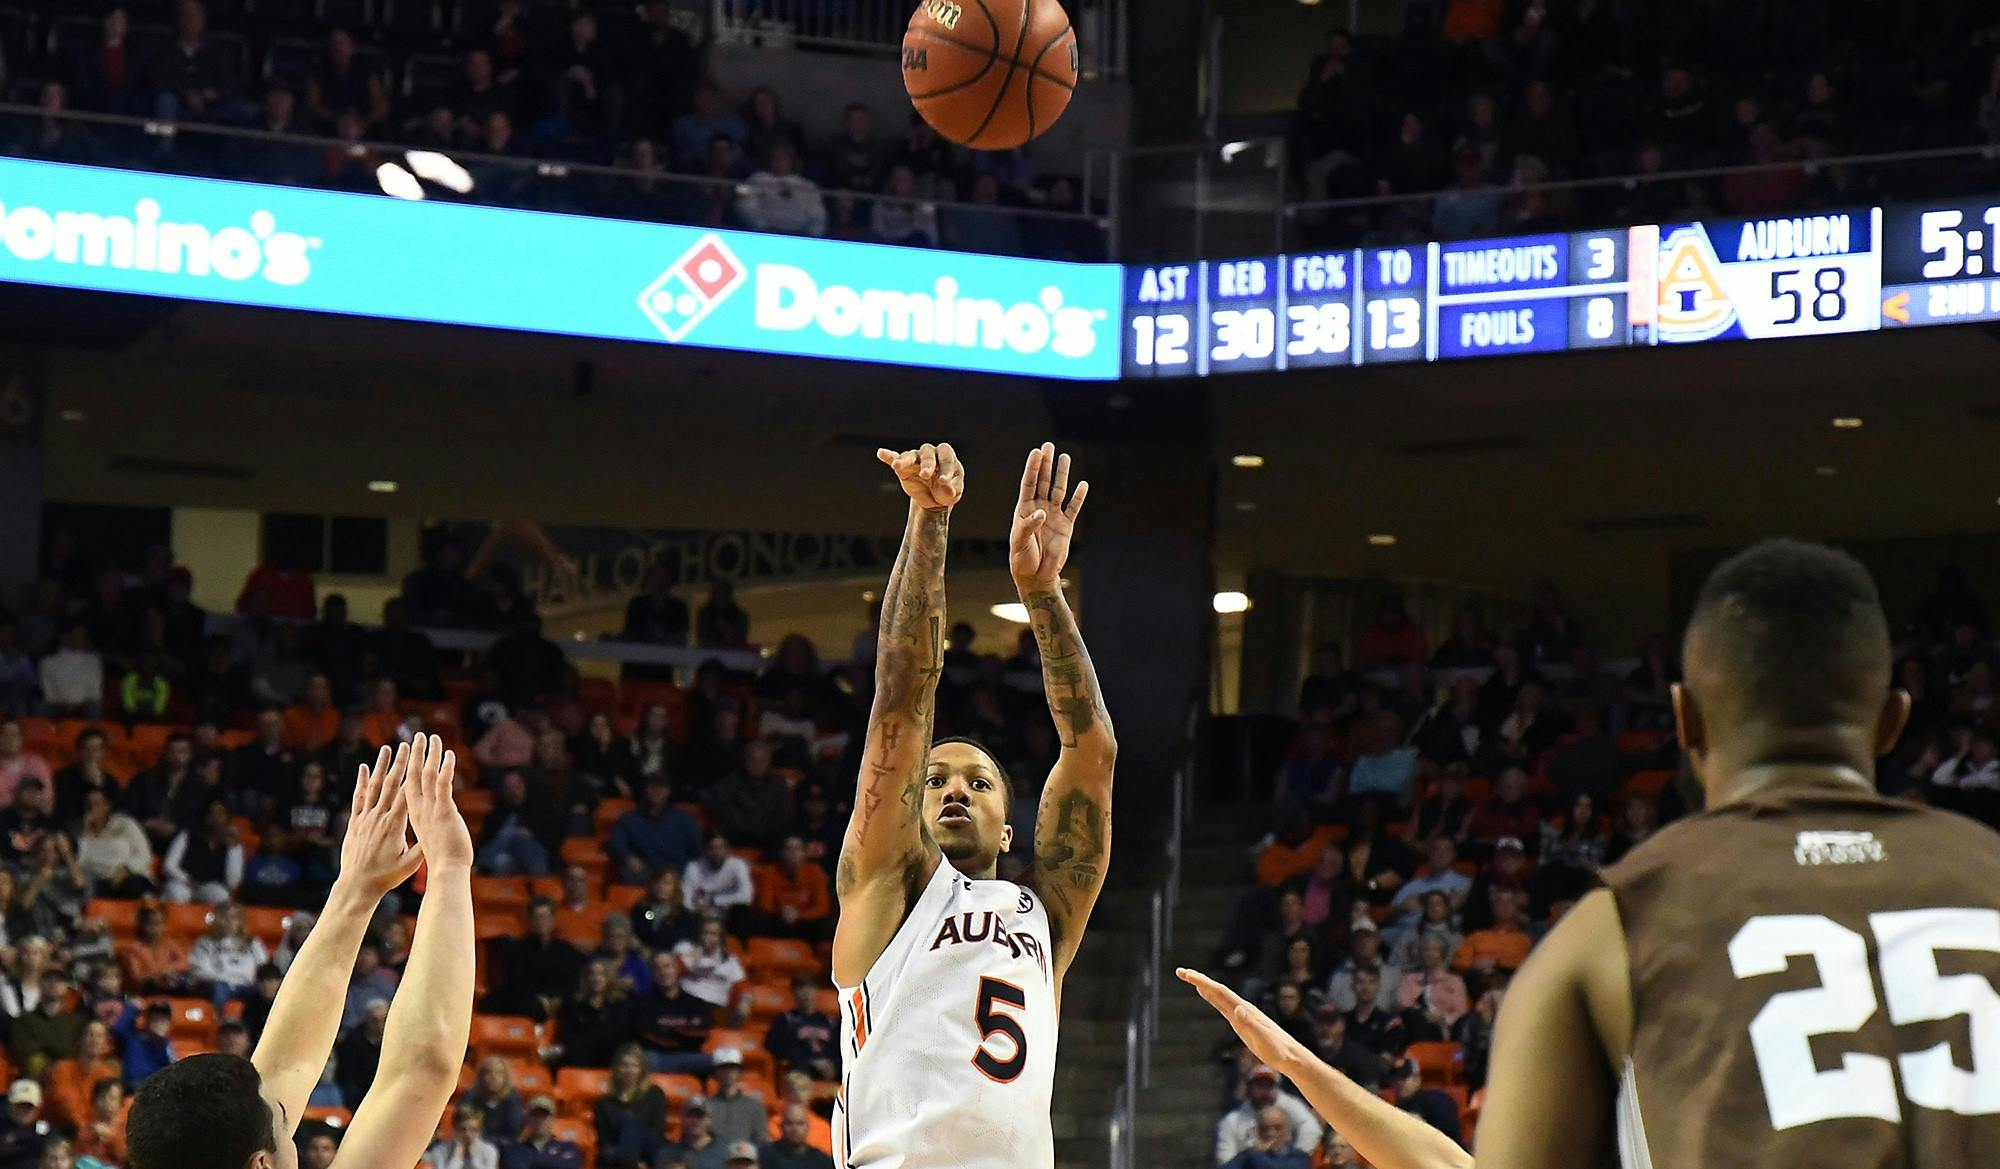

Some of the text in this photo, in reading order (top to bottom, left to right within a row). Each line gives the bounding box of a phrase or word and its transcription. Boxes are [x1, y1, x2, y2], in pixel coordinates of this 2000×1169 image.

[0, 197, 311, 285] omino's
[1586, 238, 1616, 280] 3
[1738, 214, 1850, 261] AUBURN
[1138, 267, 1190, 302] AST
[1218, 261, 1266, 297] REB
[1293, 254, 1347, 291] FG%
[1377, 249, 1412, 286] TO
[1444, 244, 1558, 287] TIMEOUTS
[755, 263, 1096, 357] Domino's
[1586, 298, 1614, 340] 8
[1771, 267, 1847, 325] 58
[1928, 282, 1985, 316] 2ND
[1132, 314, 1190, 366] 12
[1211, 308, 1275, 361] 30
[1287, 302, 1350, 355] 38
[1368, 298, 1420, 349] 13
[1460, 309, 1534, 348] FOULS
[971, 976, 1028, 1084] 5
[1727, 907, 2000, 1132] 25
